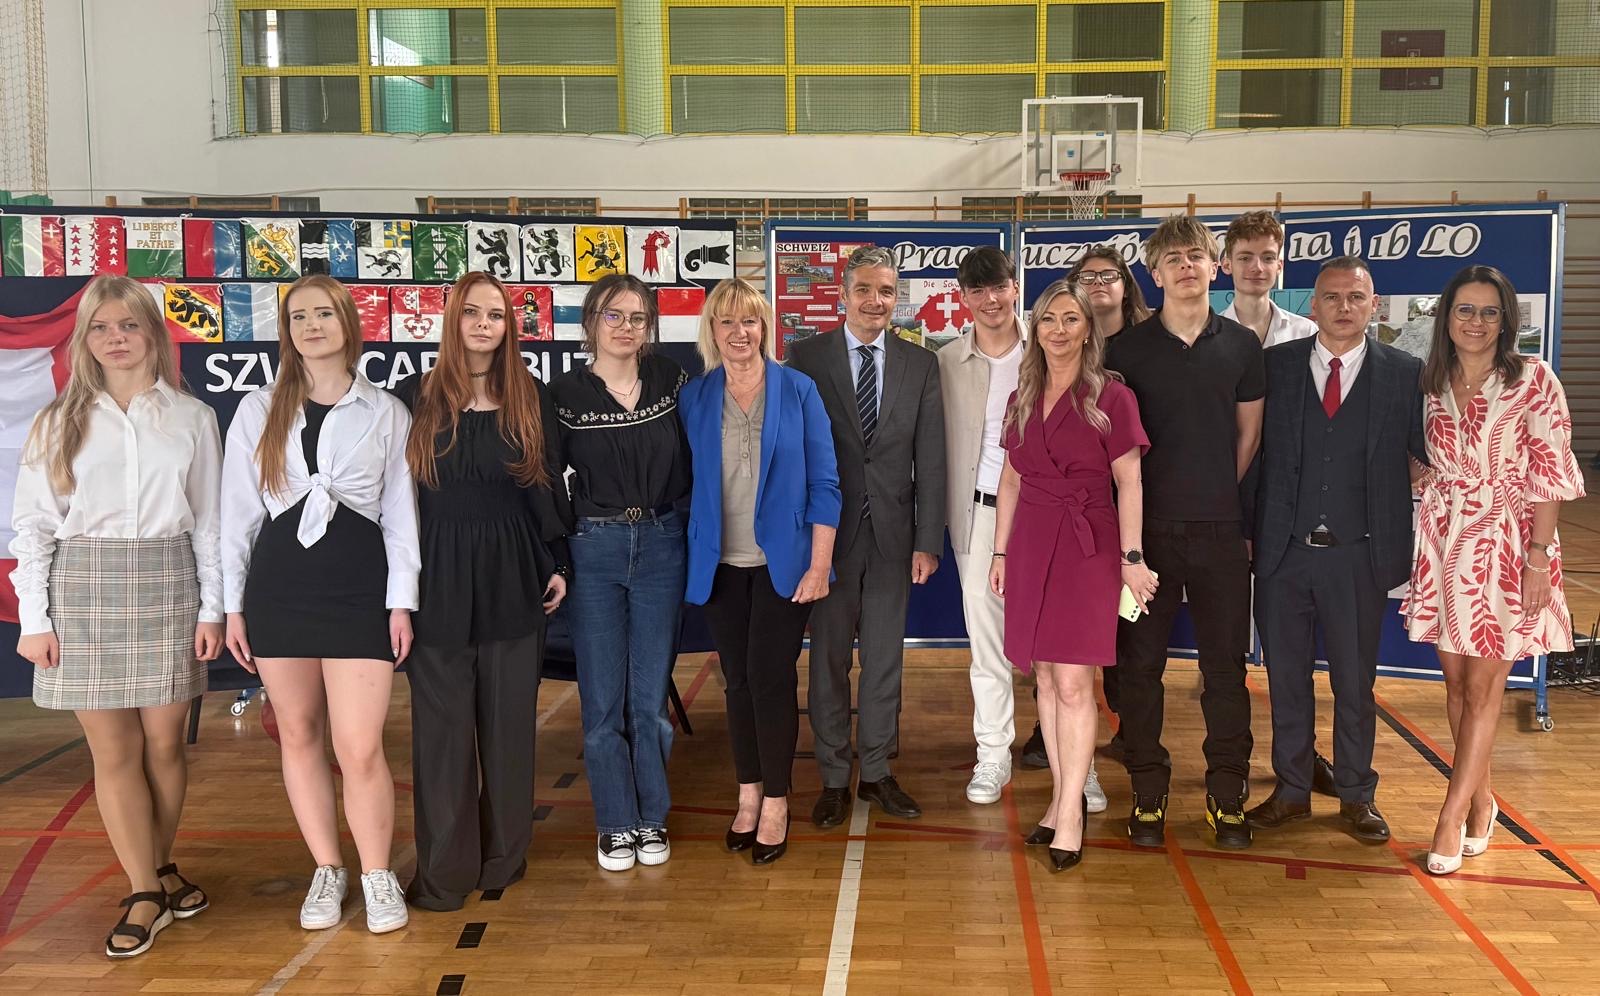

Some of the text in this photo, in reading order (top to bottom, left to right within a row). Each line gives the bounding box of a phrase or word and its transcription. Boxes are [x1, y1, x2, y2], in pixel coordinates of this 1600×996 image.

[132, 221, 178, 231] LIBERTÉ
[149, 231, 162, 239] ET
[136, 240, 175, 248] PATRIE
[776, 243, 830, 252] SCHWEIZ
[893, 243, 971, 270] Prac
[1418, 225, 1479, 256] LO
[526, 254, 572, 268] V R
[923, 280, 935, 288] Die
